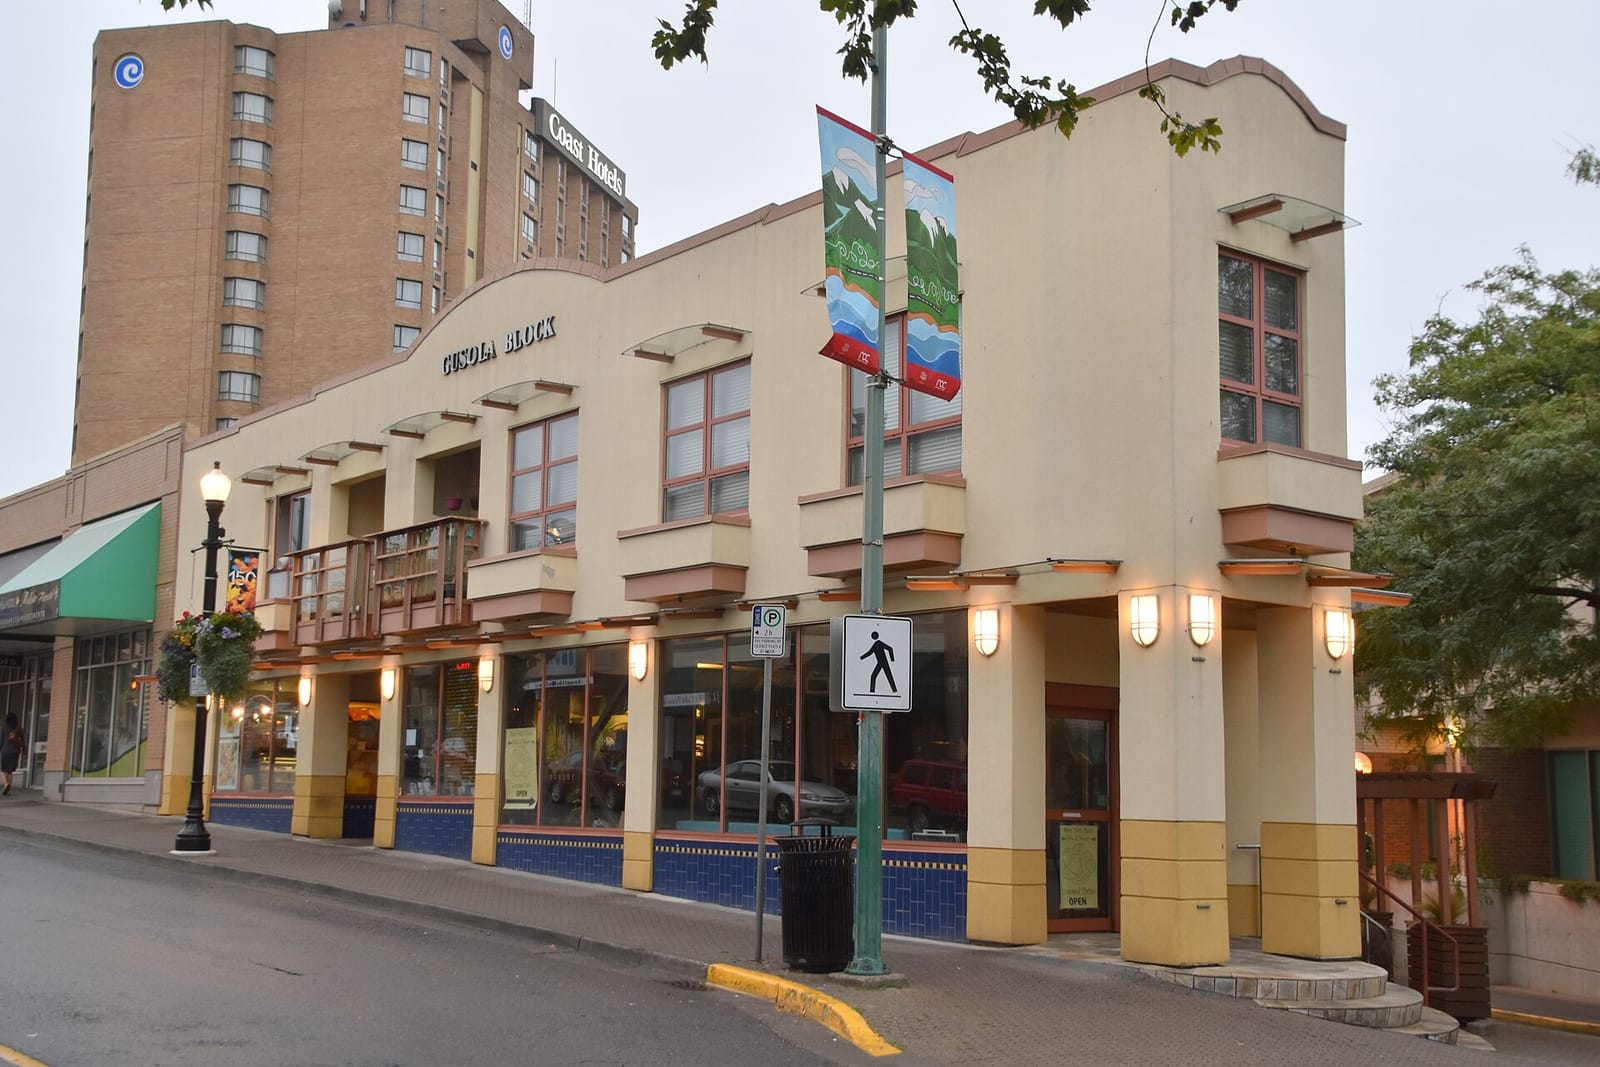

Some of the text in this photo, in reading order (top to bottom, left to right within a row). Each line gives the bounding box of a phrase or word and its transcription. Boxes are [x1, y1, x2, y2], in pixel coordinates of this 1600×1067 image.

[549, 113, 622, 196] Coast Hotels
[441, 316, 556, 376] GUSOLA BLOCK
[228, 570, 257, 586] 150
[769, 613, 777, 623] P
[1069, 897, 1087, 906] OPEN
